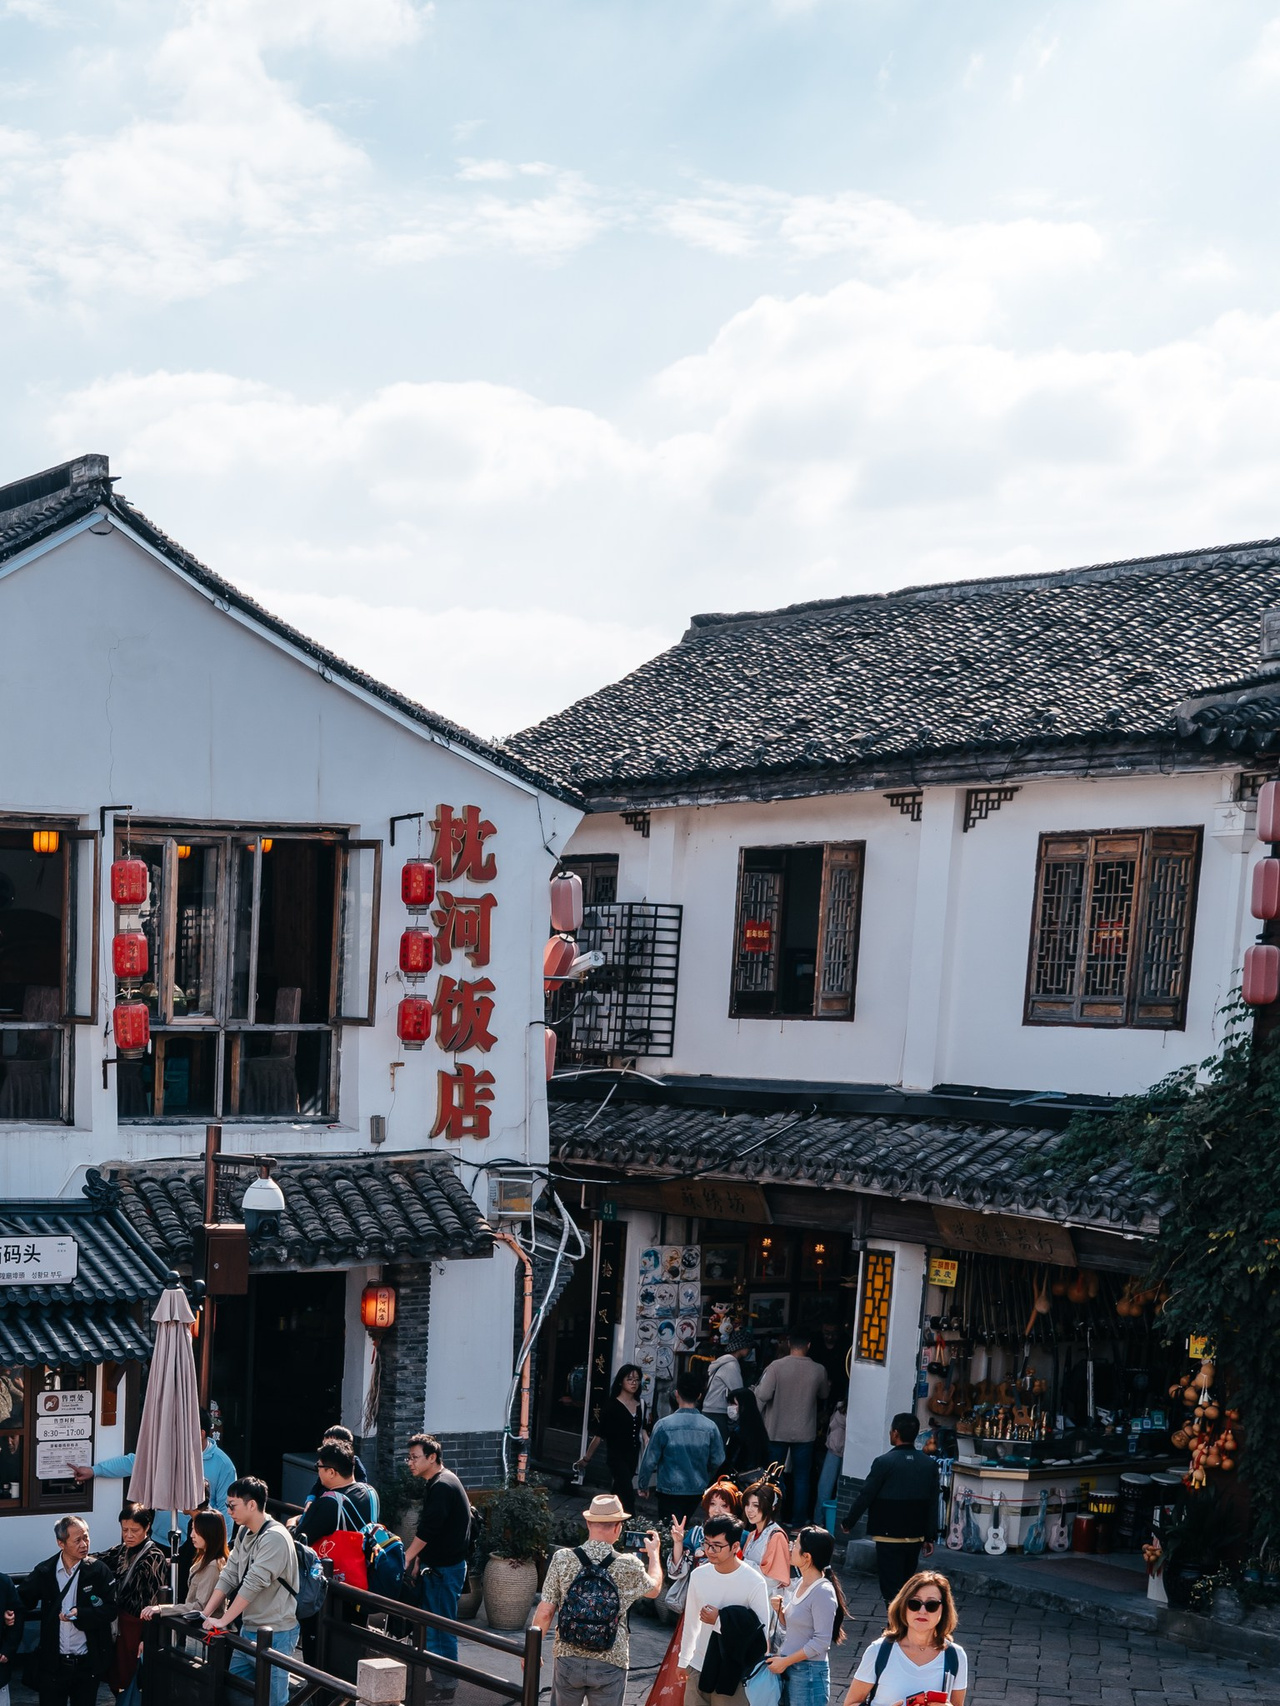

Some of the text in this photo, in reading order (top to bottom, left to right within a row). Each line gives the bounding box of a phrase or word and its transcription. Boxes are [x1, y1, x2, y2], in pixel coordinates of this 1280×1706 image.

[428, 803, 499, 1140] 枕河饭店
[604, 1203, 613, 1214] 61
[61, 1393, 85, 1402] 售票处
